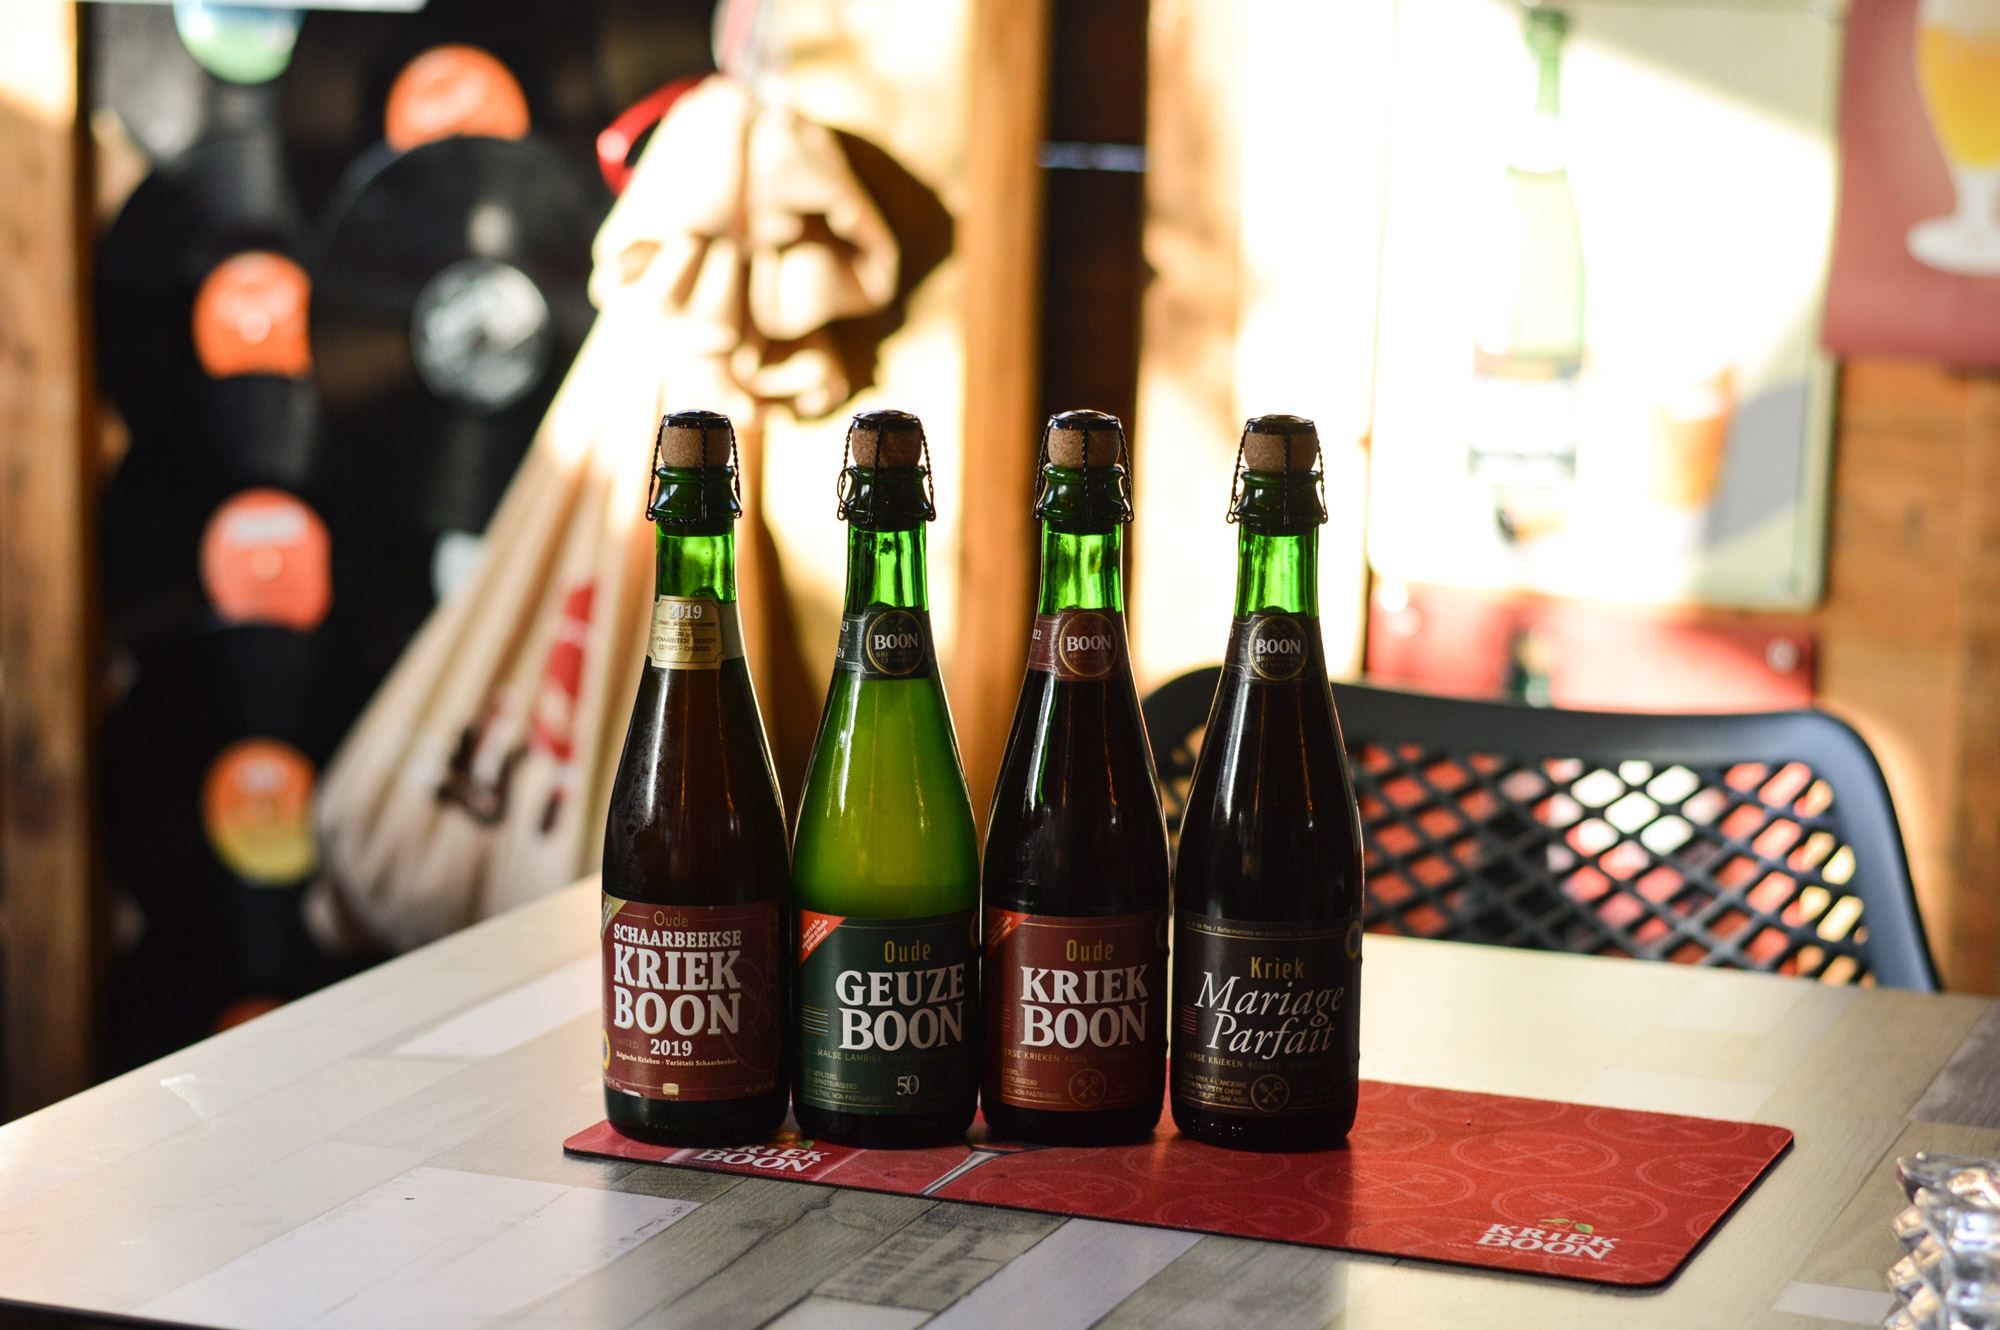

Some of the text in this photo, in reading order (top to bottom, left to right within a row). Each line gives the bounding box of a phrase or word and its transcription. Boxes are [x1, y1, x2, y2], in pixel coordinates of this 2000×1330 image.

[670, 604, 702, 619] 2019
[874, 633, 918, 650] BOON
[1066, 635, 1111, 652] BOON
[1255, 638, 1301, 654] BOON
[653, 910, 689, 927] Oude
[614, 923, 742, 948] SCHAARBEEKSE
[883, 939, 931, 963] Oude
[1066, 939, 1114, 962] Oude
[614, 942, 742, 991] KRIEK
[1250, 955, 1304, 979] Kriek
[835, 962, 965, 1007] GEUZE
[1020, 963, 1149, 1005] KRIEK
[614, 985, 742, 1036] BOON
[1194, 971, 1345, 1027] Mariage
[838, 1000, 965, 1052] BOON
[1020, 1001, 1149, 1049] BOON
[1206, 1012, 1335, 1060] Parfait
[650, 1038, 692, 1057] 2019
[1208, 1056, 1244, 1068] KRIEKEN
[896, 1074, 920, 1095] 50
[694, 1149, 818, 1172] BOON
[722, 1145, 831, 1161] RIEK
[1475, 1233, 1612, 1260] BOON
[1485, 1223, 1620, 1249] KRIEK
